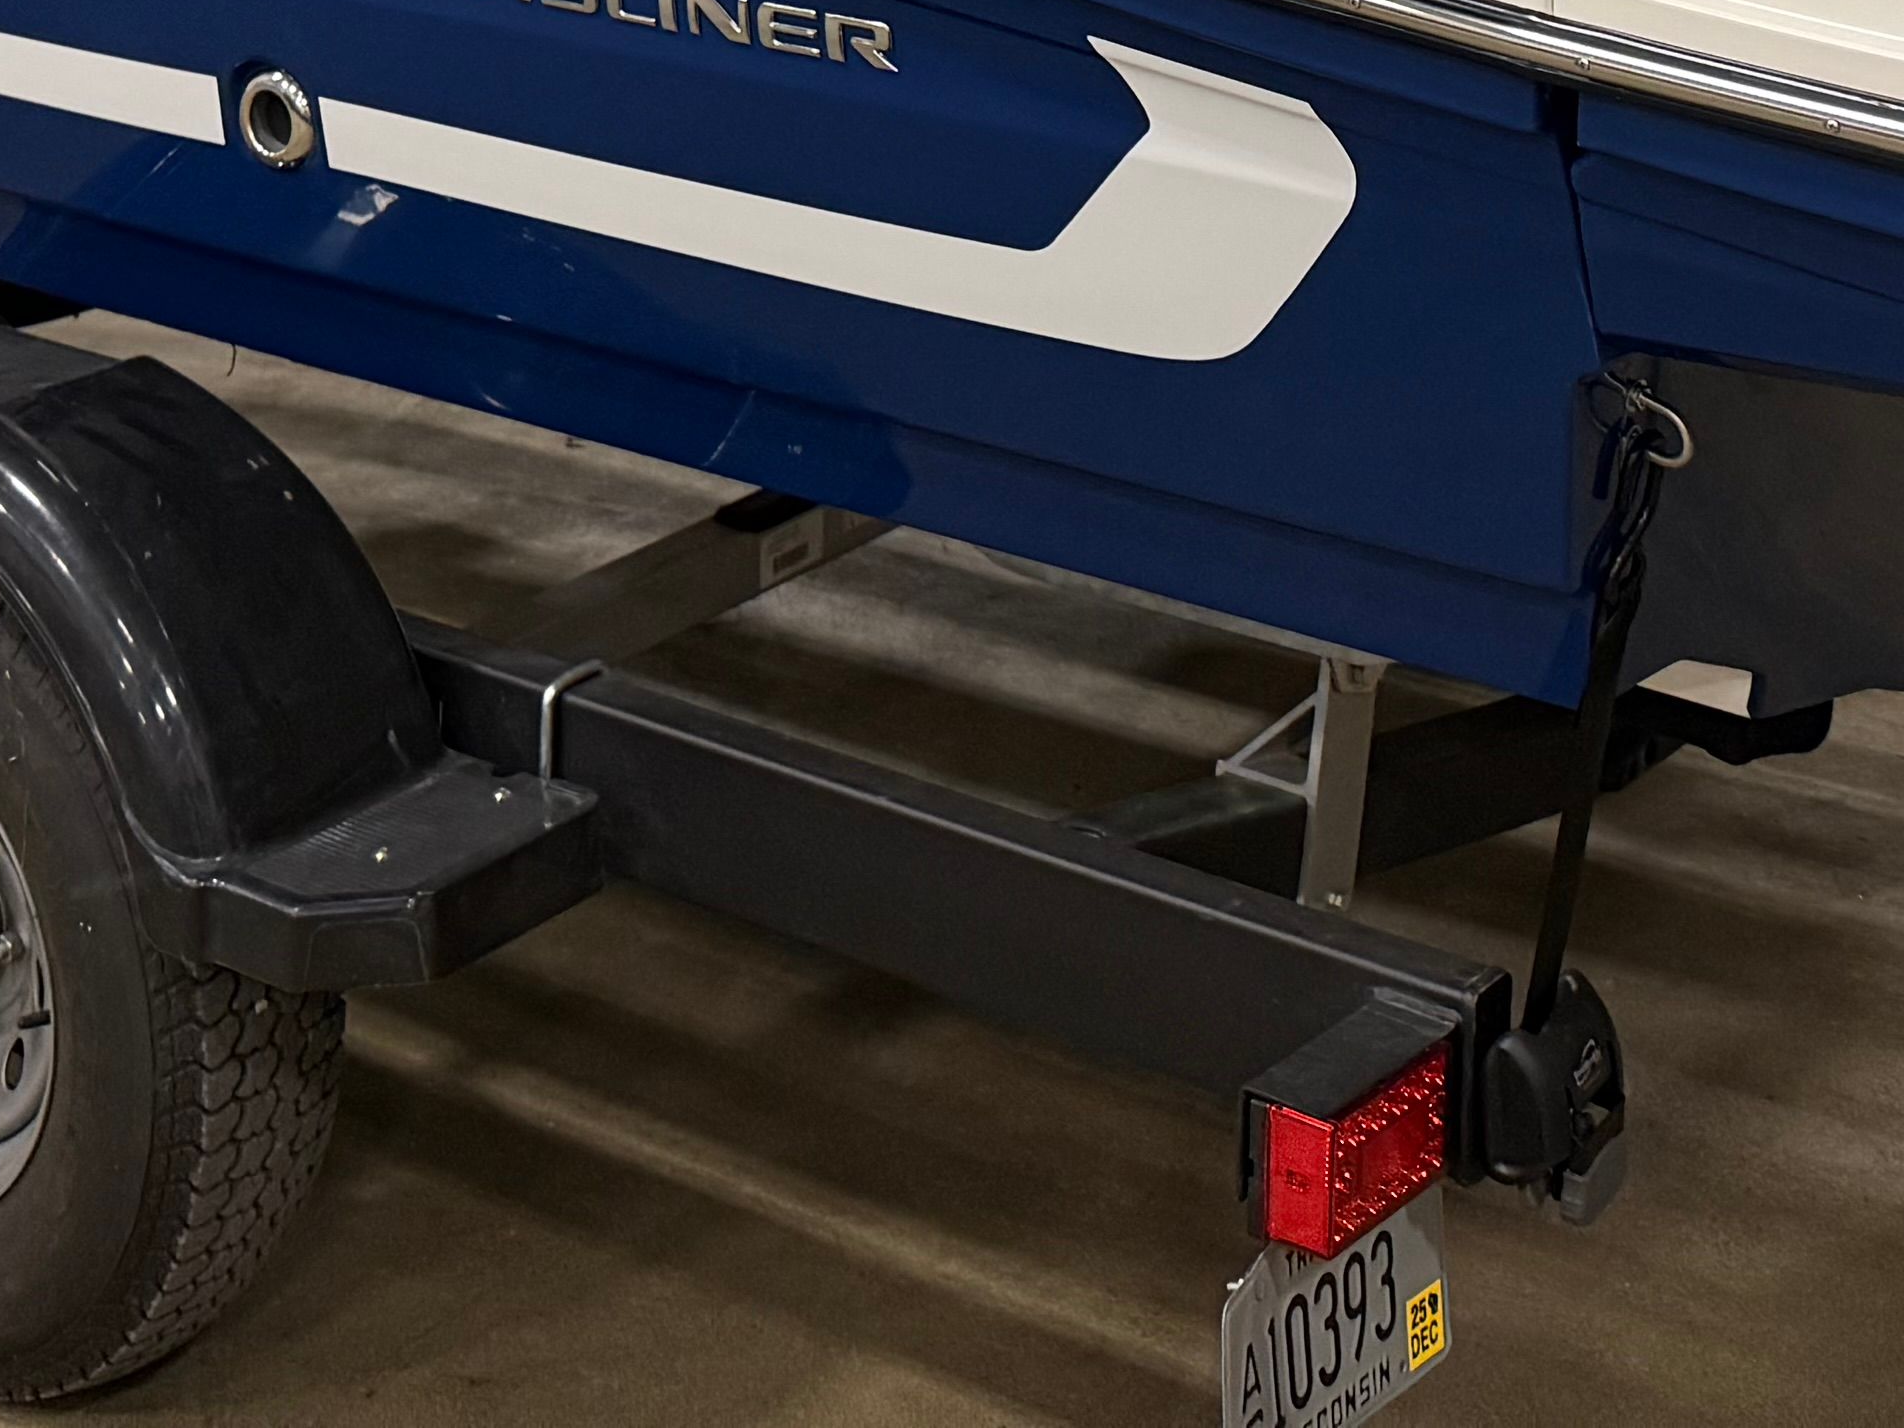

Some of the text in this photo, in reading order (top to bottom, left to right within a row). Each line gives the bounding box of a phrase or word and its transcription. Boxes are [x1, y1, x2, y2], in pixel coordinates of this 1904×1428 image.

[1267, 1230, 1396, 1428] 10393
[1410, 1297, 1427, 1329] 25
[1410, 1321, 1439, 1360] DEC
